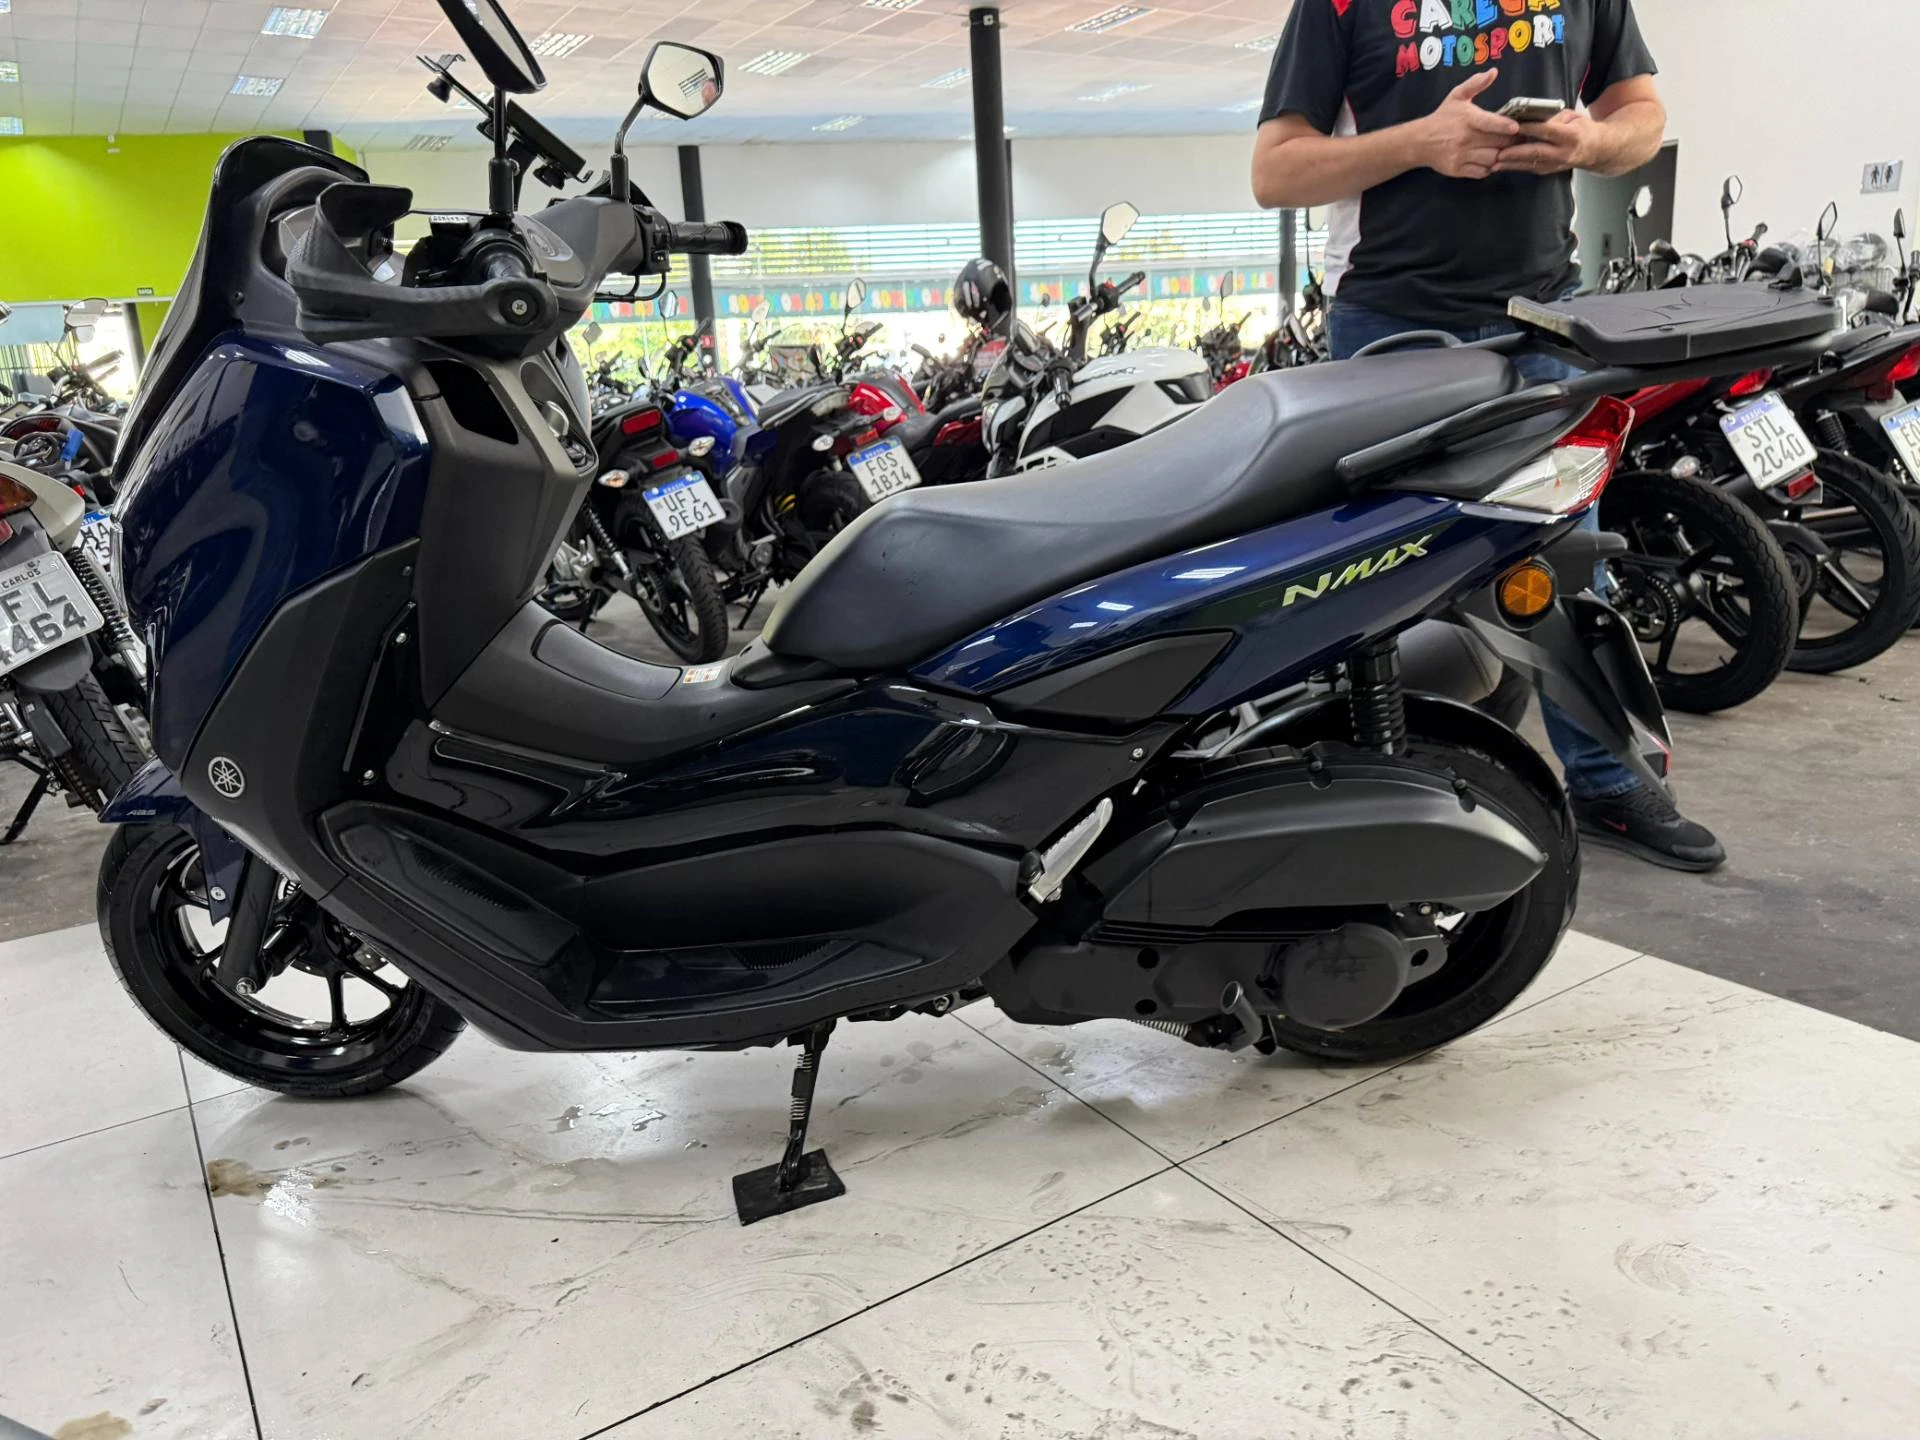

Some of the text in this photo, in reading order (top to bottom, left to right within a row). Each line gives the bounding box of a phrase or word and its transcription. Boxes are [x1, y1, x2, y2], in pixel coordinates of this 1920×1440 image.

[1395, 14, 1564, 77] MOTOSPORT
[1743, 415, 1785, 449] STL
[1753, 433, 1805, 477] 2C40
[871, 465, 911, 495] 1B14
[668, 501, 717, 532] 9E61
[2, 569, 41, 589] CARLOS
[1282, 534, 1432, 607] NMAX
